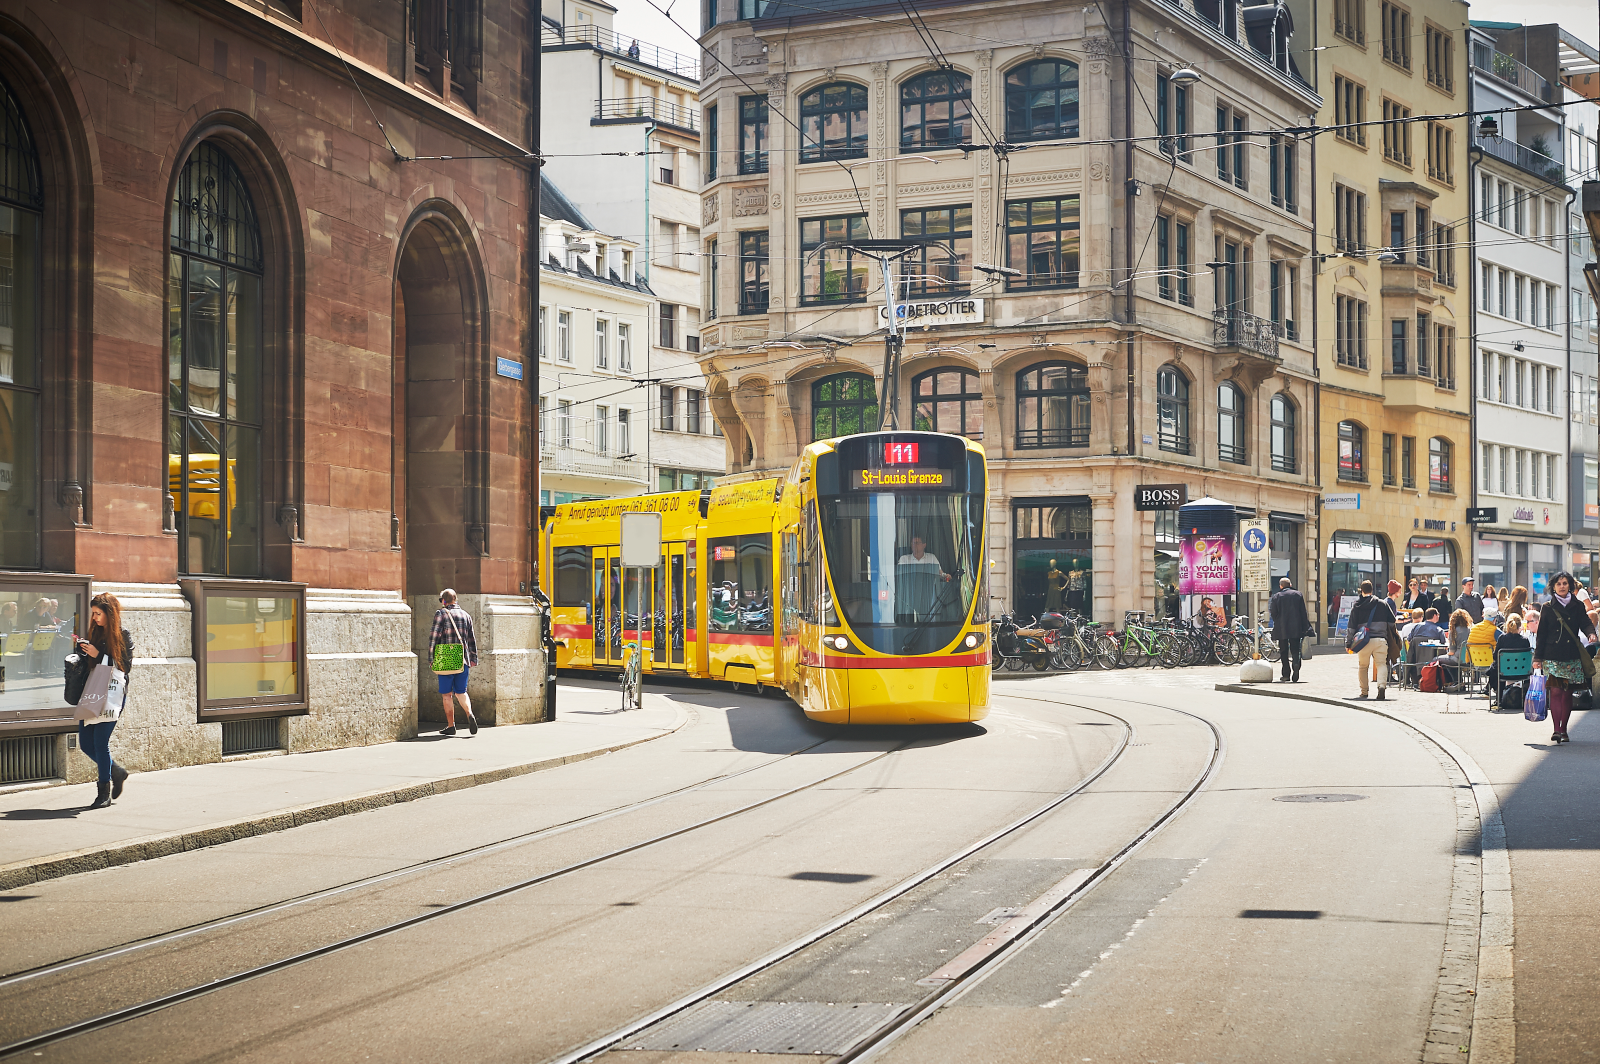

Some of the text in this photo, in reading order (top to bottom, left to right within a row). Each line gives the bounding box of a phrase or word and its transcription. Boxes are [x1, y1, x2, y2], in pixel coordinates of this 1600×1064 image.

[881, 301, 975, 319] GOBETROTTER
[930, 315, 977, 324] SERVICE
[893, 444, 912, 462] 11
[862, 469, 942, 484] St-Louis Grenze
[1142, 489, 1180, 501] BOSS
[568, 496, 680, 522] Anruf genügt unter 061 361 08 00
[1196, 571, 1229, 579] STAGE
